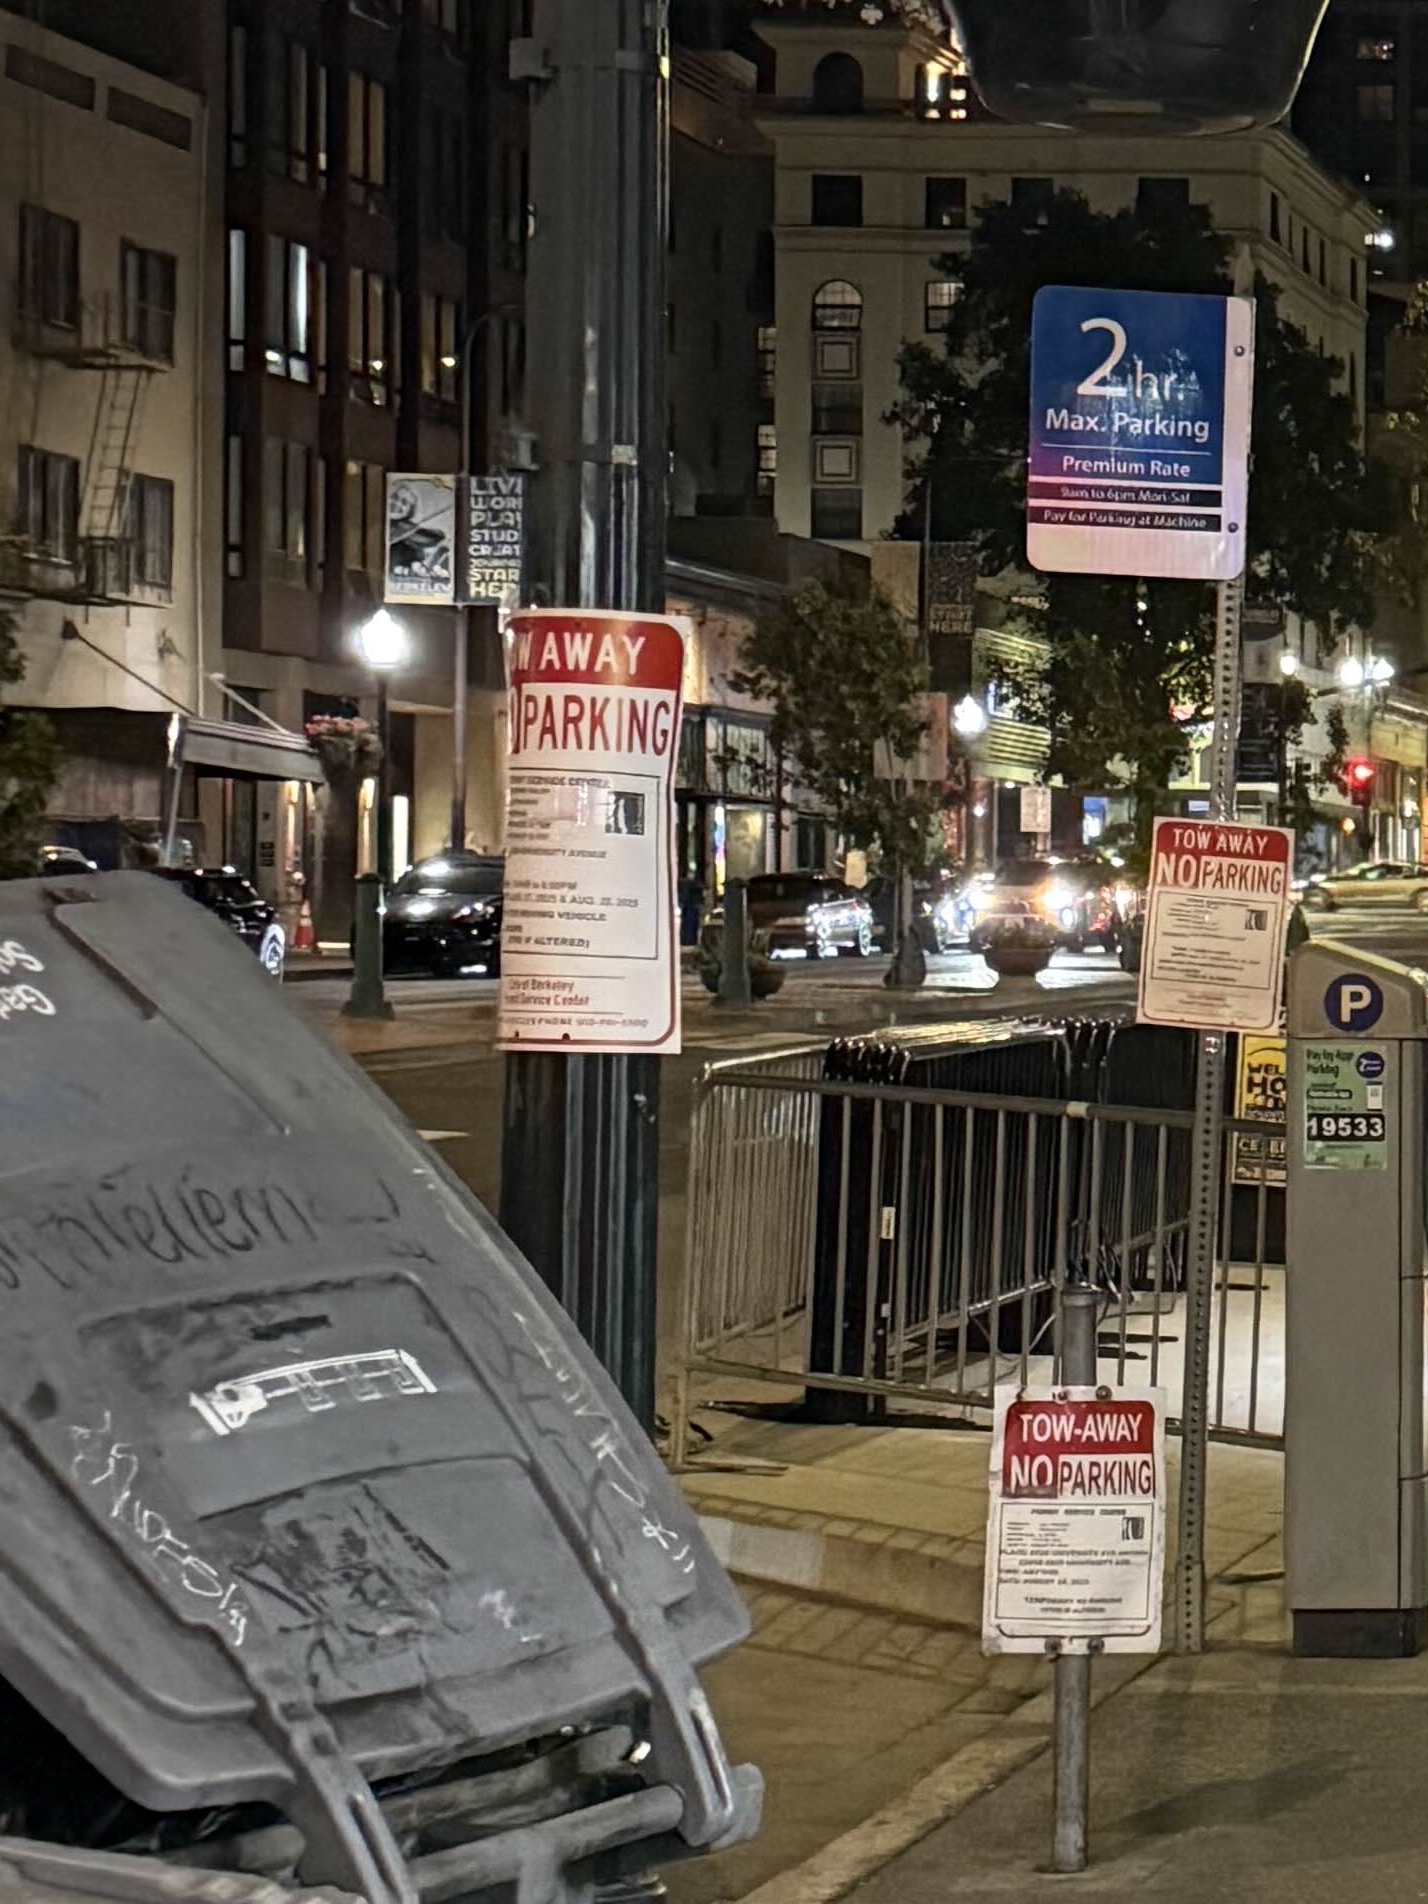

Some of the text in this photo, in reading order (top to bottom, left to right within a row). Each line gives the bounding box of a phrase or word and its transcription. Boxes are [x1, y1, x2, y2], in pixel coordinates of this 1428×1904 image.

[1046, 408, 1209, 443] Max. Parking
[1063, 456, 1190, 477] Premium Rate
[1107, 489, 1136, 502] 6pm
[1043, 509, 1065, 522] Pay
[1068, 510, 1086, 521] for
[1089, 511, 1135, 526] Parking
[1154, 514, 1207, 527] Machine
[539, 631, 646, 675] AWAY
[523, 694, 671, 757] PARKING
[1173, 827, 1268, 855] TOW AWAY
[1156, 852, 1282, 894] NO PARKING
[1341, 985, 1371, 1022] P
[1307, 1117, 1383, 1137] 19533
[1020, 1412, 1142, 1443] TOW-AWAY
[1010, 1454, 1152, 1496] NO PARKING
